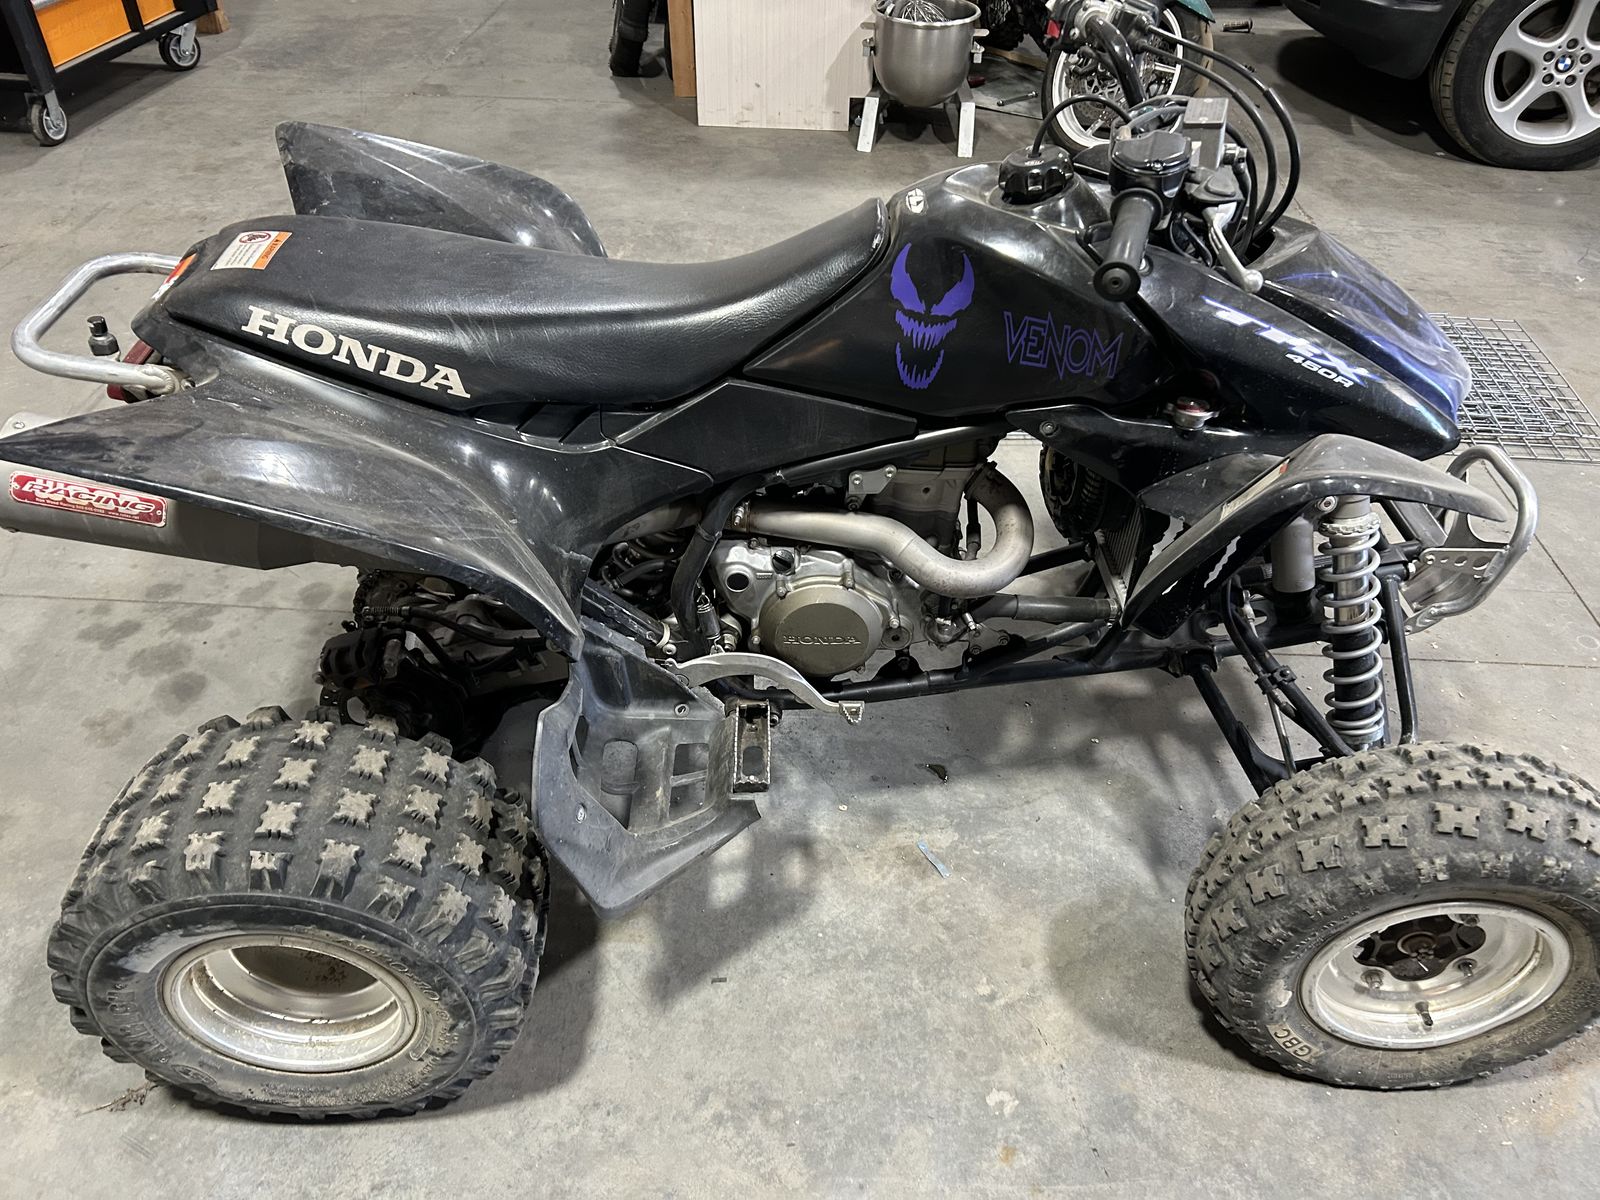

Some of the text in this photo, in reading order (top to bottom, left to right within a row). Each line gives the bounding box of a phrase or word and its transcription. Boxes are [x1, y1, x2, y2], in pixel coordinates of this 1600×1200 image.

[241, 305, 471, 399] HONDA
[1003, 311, 1124, 380] VENOM
[1285, 352, 1355, 388] 450R
[22, 481, 156, 512] RACING
[783, 635, 862, 645] HONDA
[1273, 1027, 1312, 1057] GBC
